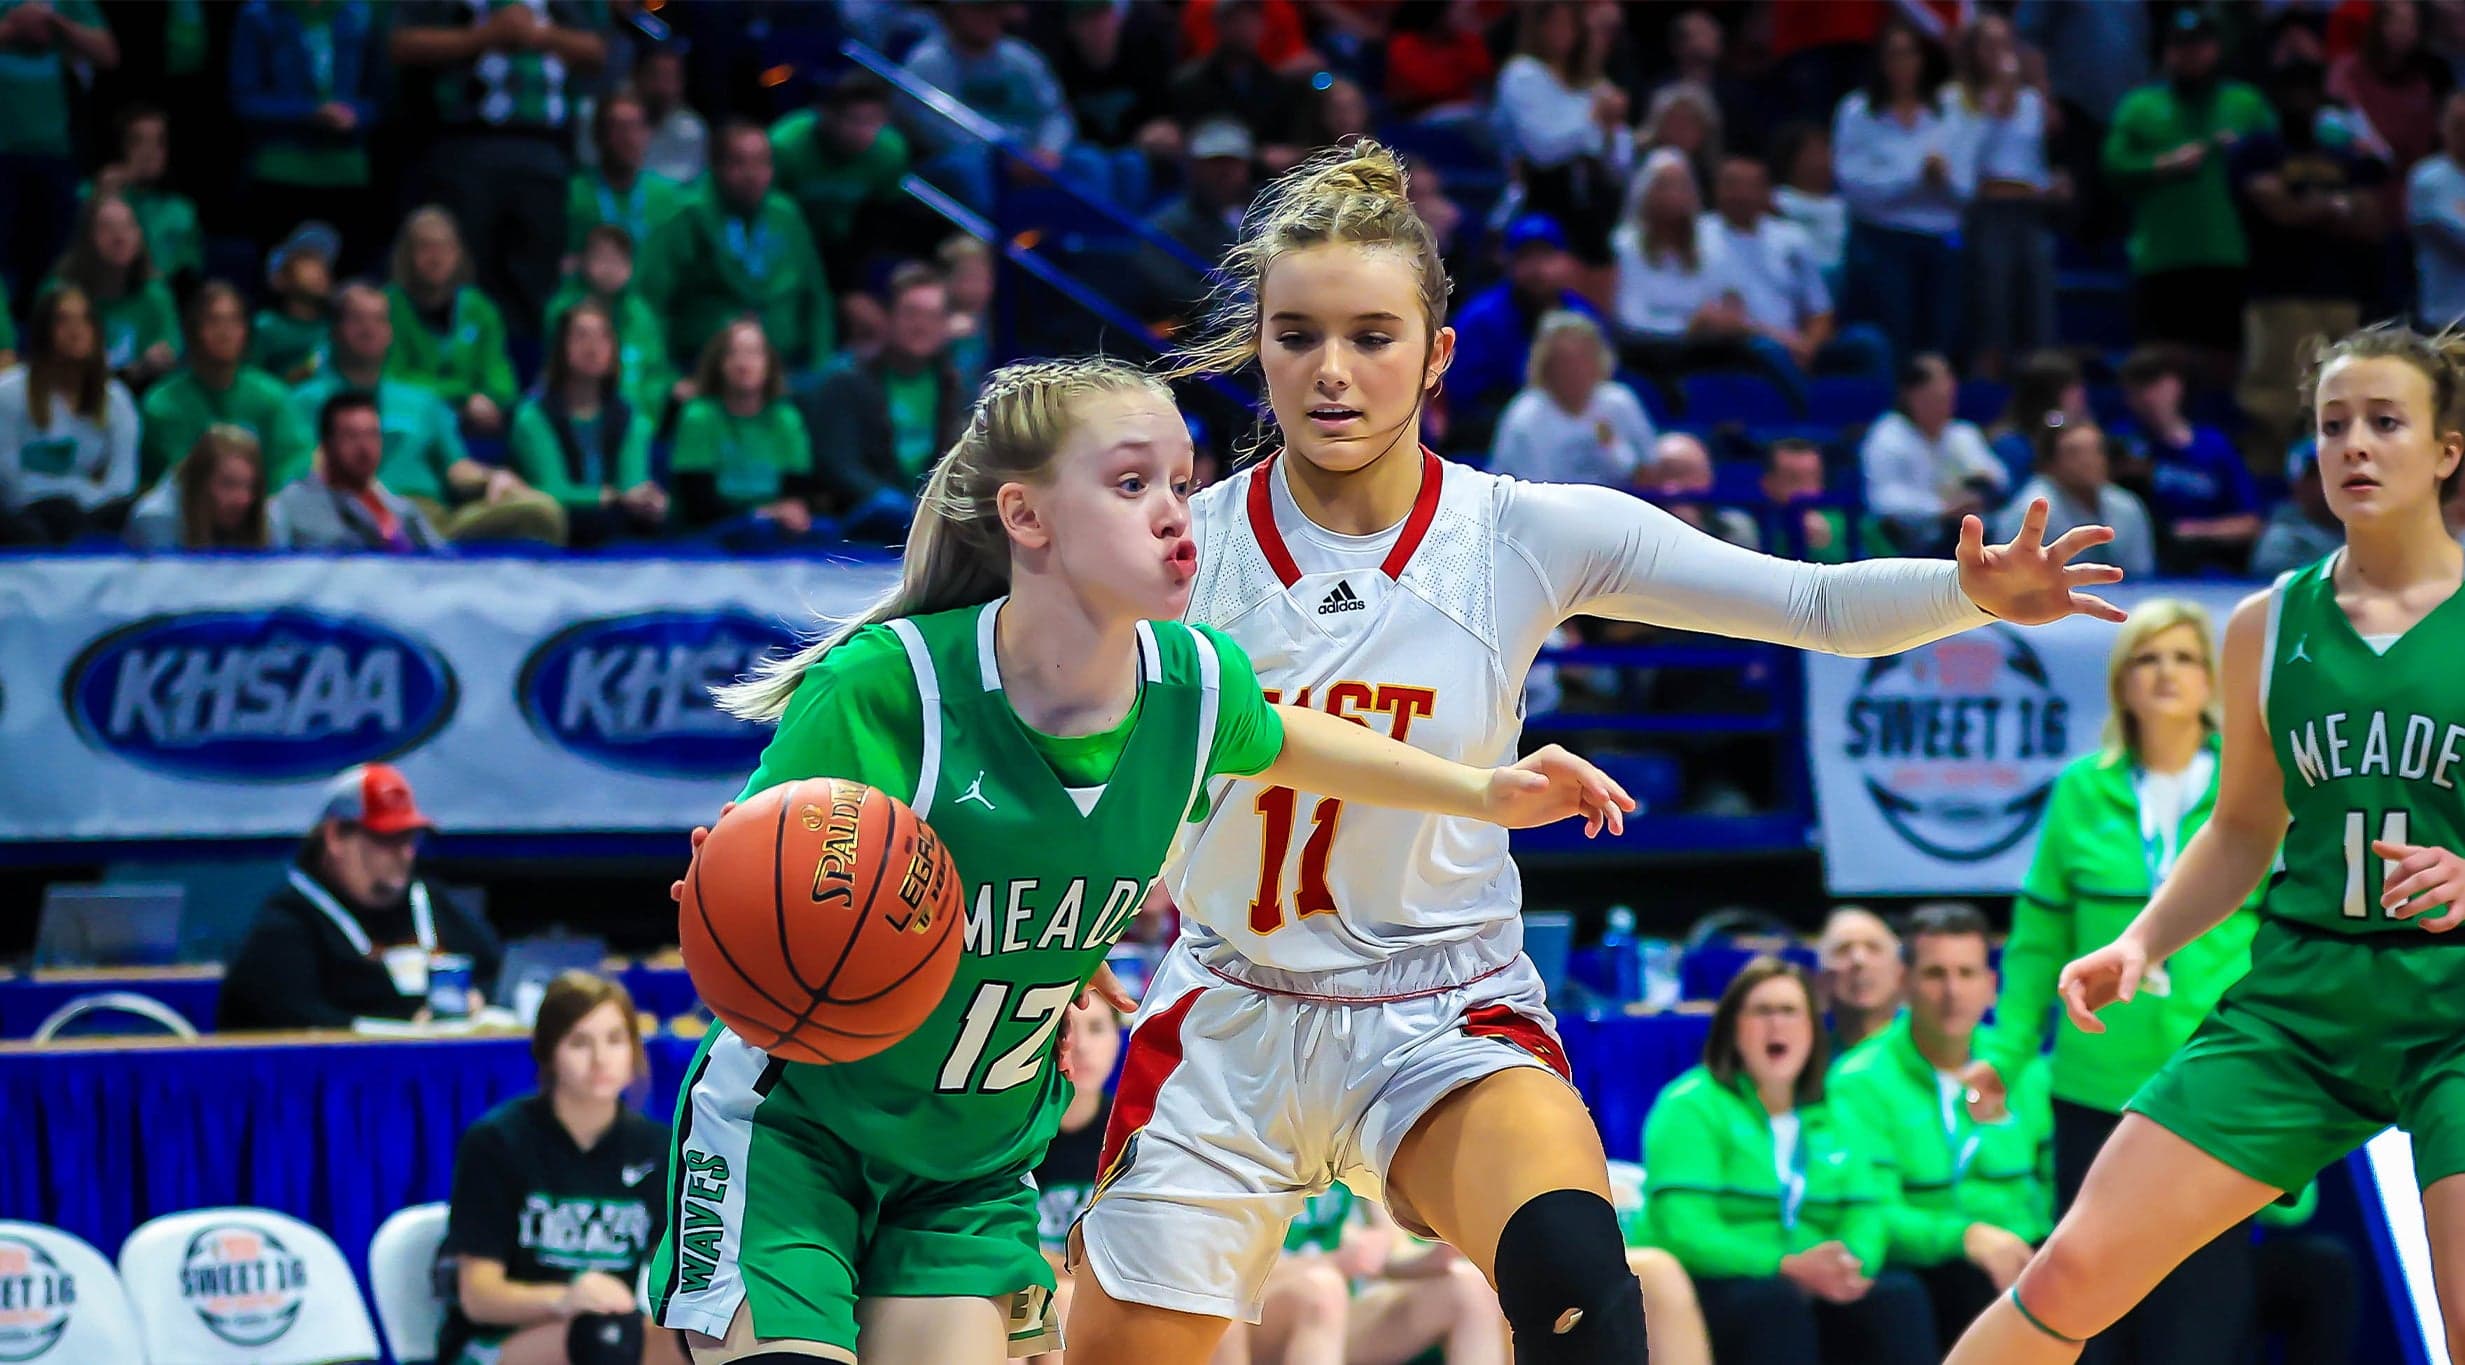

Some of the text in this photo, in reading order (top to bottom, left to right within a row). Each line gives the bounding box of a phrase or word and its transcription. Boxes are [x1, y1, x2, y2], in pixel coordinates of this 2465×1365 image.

[1317, 600, 1365, 614] adidas
[110, 646, 402, 743] KHSAA
[560, 646, 768, 742] KHS
[1264, 680, 1437, 744] ST
[1845, 696, 2069, 759] SWEET 16
[2289, 709, 2465, 789] MEADE
[1248, 784, 1343, 935] 11
[934, 976, 1081, 1094] 12
[680, 1150, 730, 1294] WAVES
